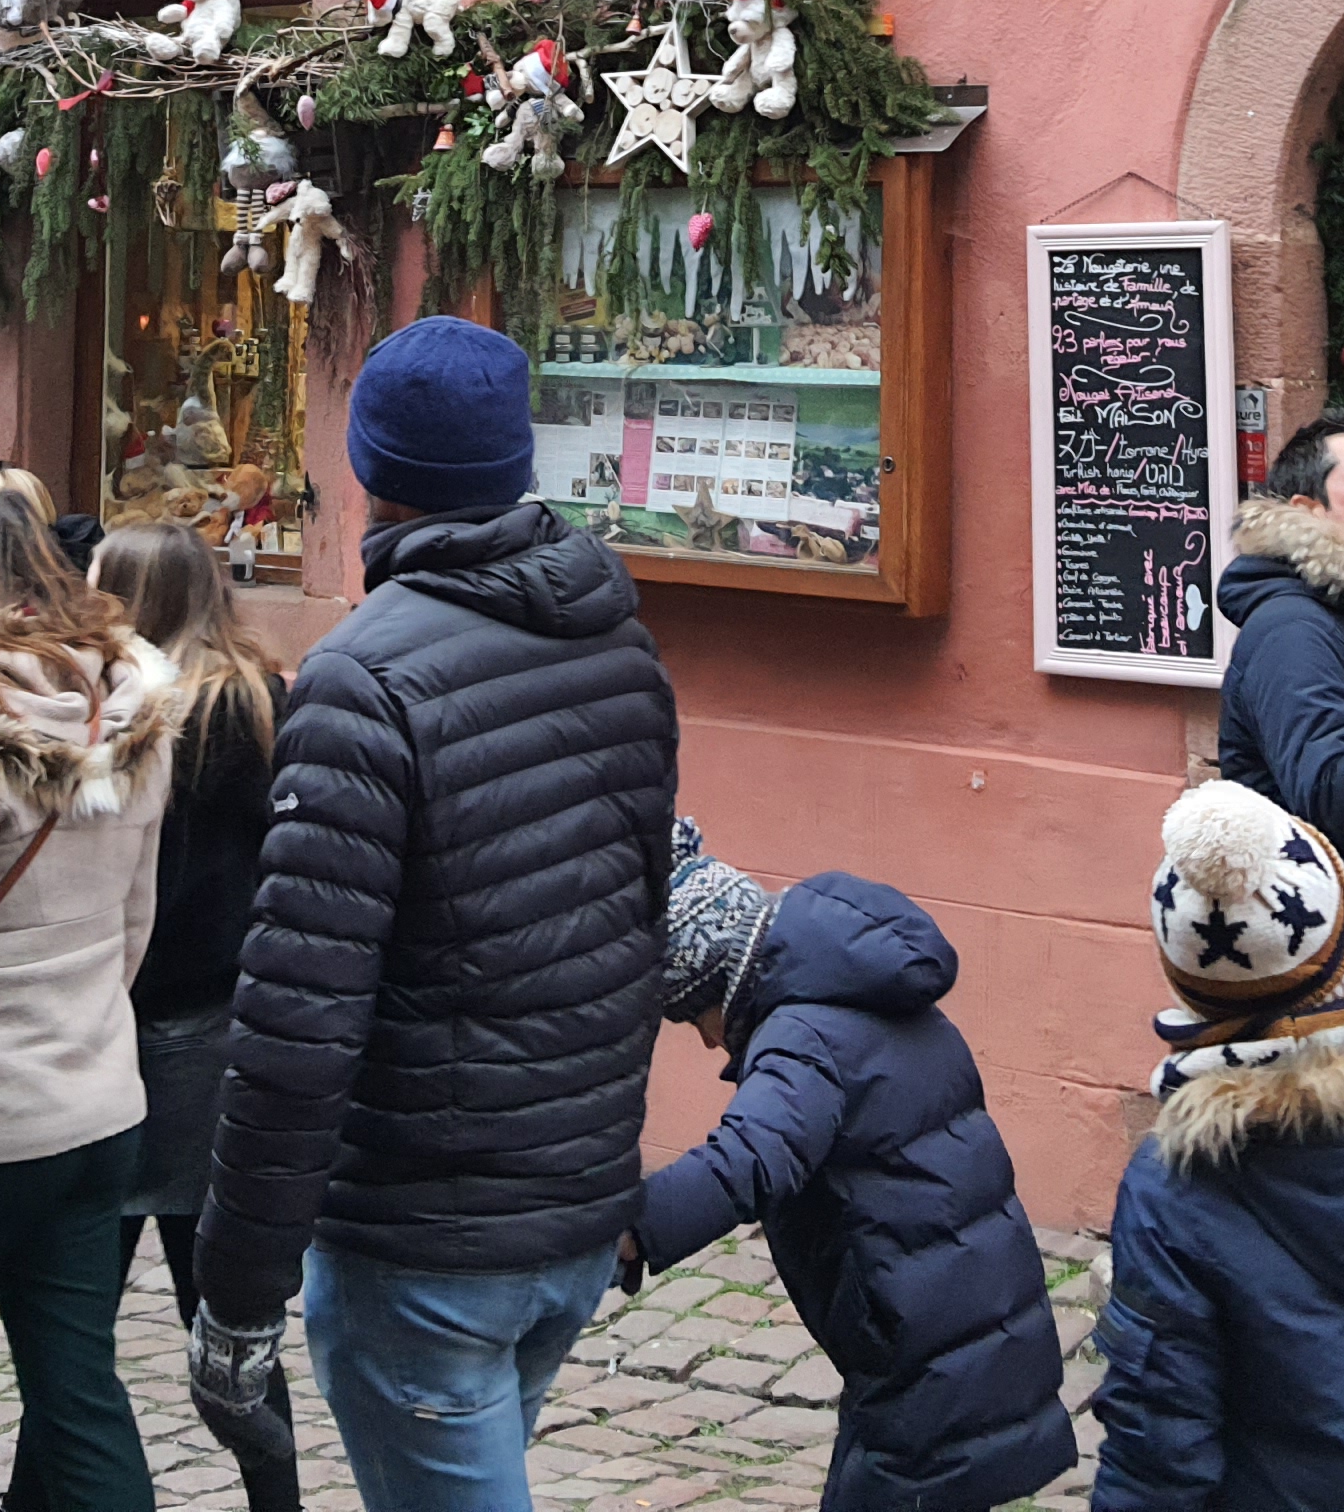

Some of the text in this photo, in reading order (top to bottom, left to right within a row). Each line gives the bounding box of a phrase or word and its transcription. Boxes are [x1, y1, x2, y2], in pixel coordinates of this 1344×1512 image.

[1053, 255, 1078, 274] La
[1054, 278, 1101, 292] histoire
[1102, 280, 1122, 292] de
[1180, 280, 1199, 295] de
[1053, 292, 1098, 311] partage
[1099, 295, 1112, 307] et
[1052, 325, 1078, 354] 23
[1126, 338, 1151, 354] pour
